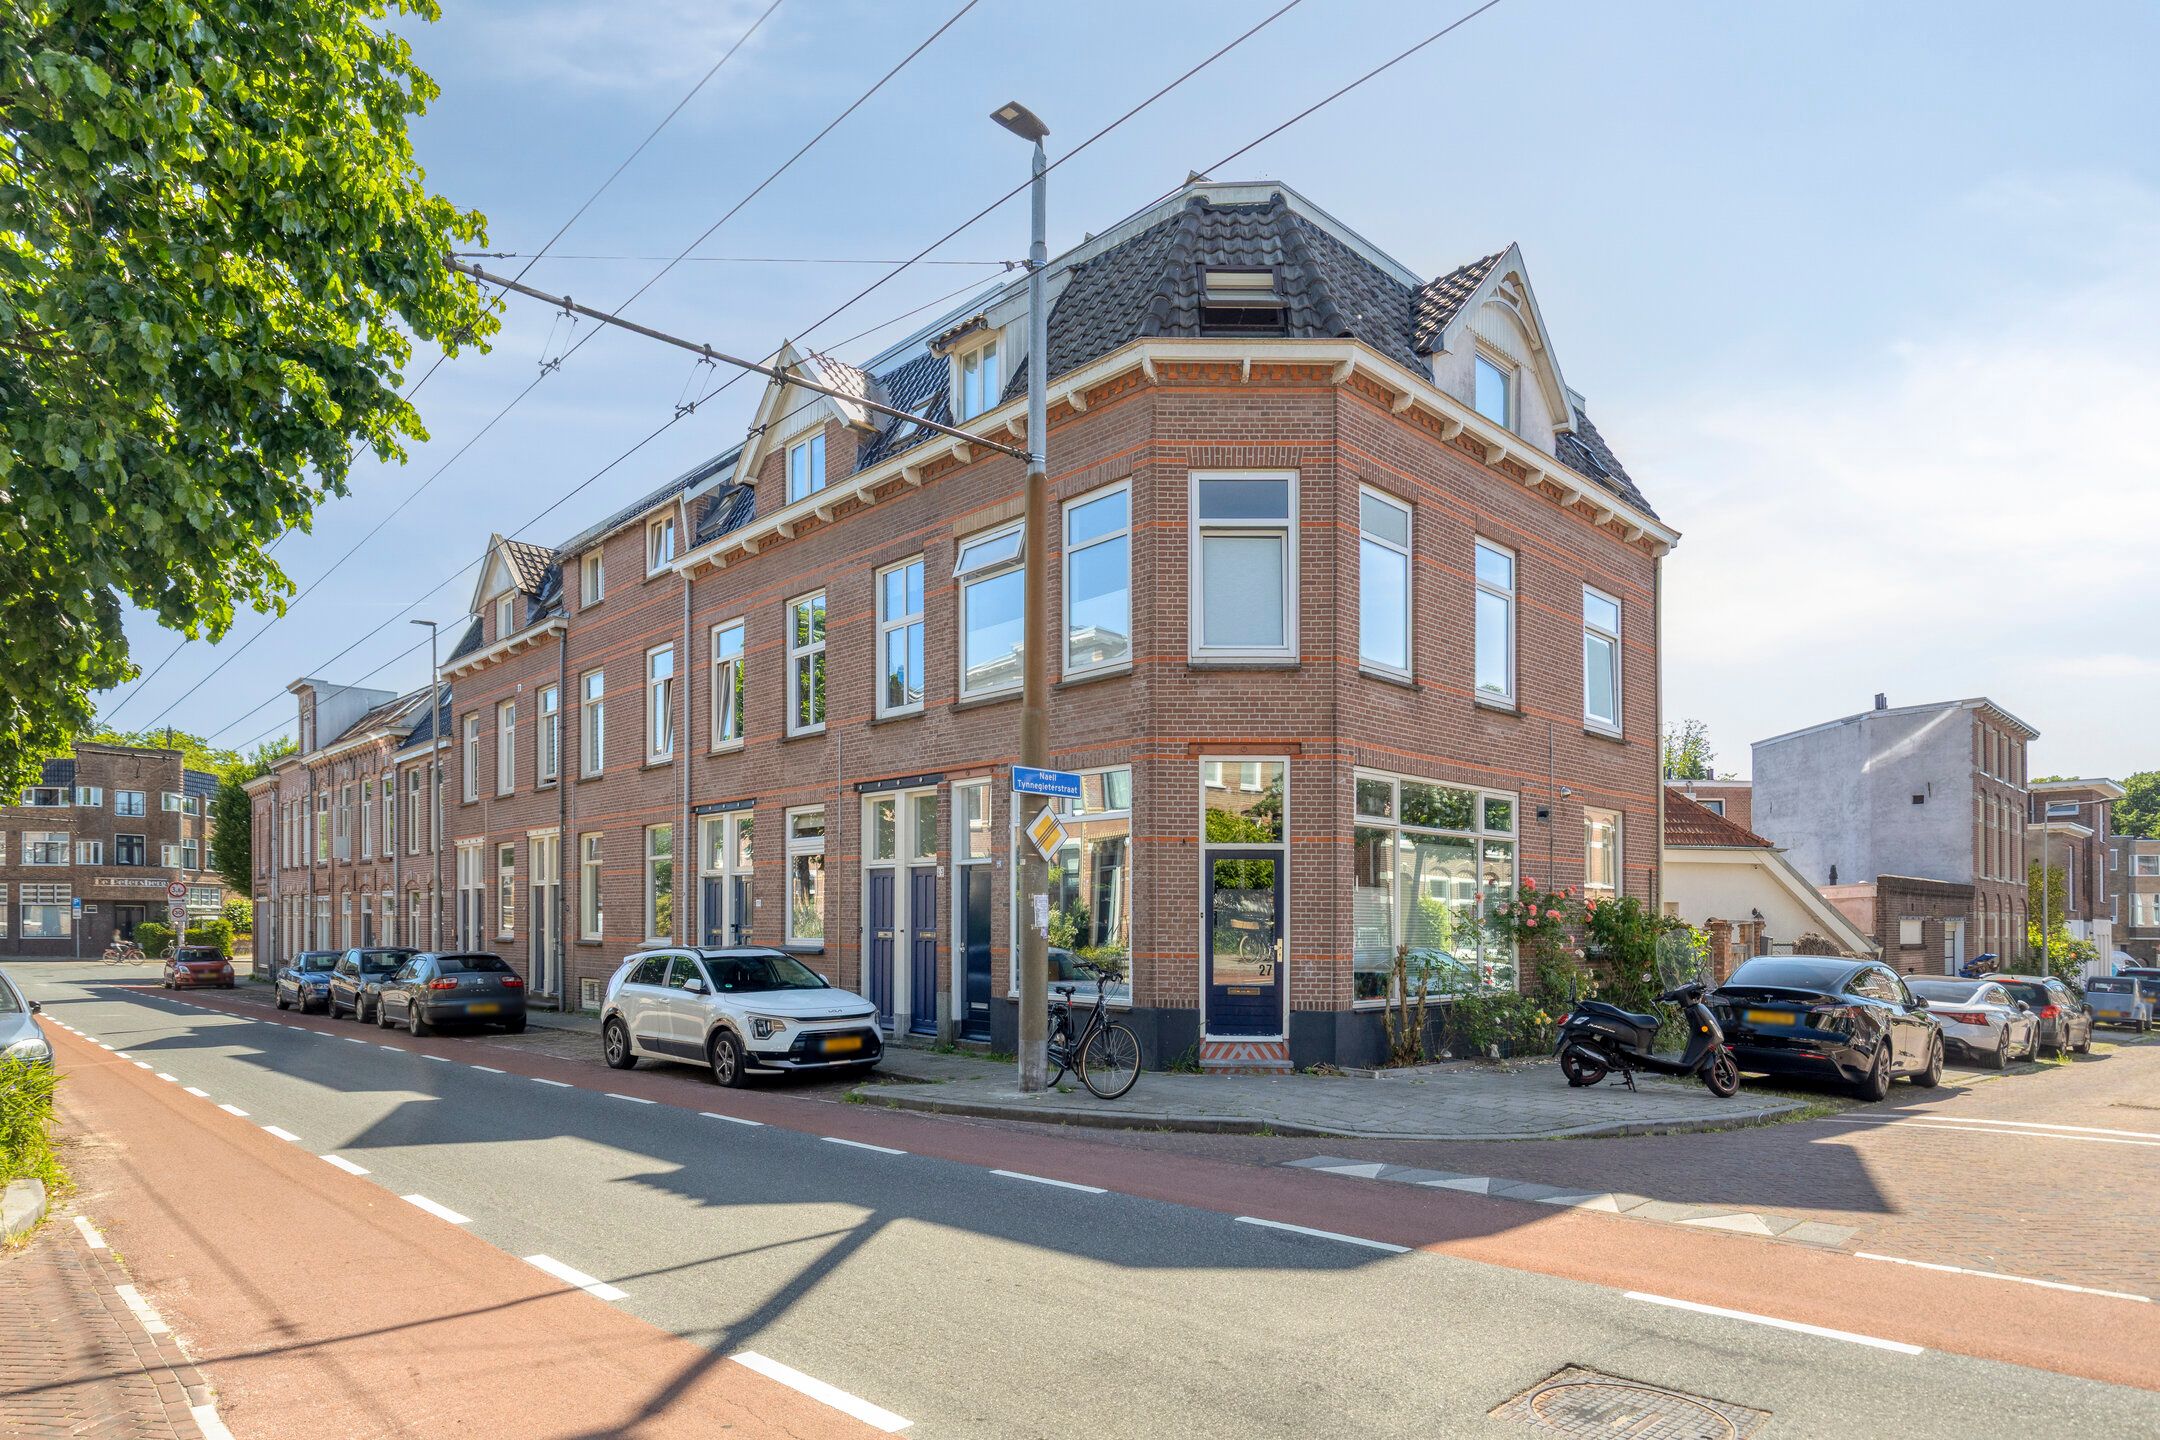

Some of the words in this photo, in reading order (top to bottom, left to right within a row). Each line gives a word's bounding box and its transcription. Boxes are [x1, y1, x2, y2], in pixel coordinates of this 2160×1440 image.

[1039, 771, 1057, 782] Naell
[1017, 779, 1078, 794] Tynnegieterstraat
[1259, 964, 1272, 976] 27
